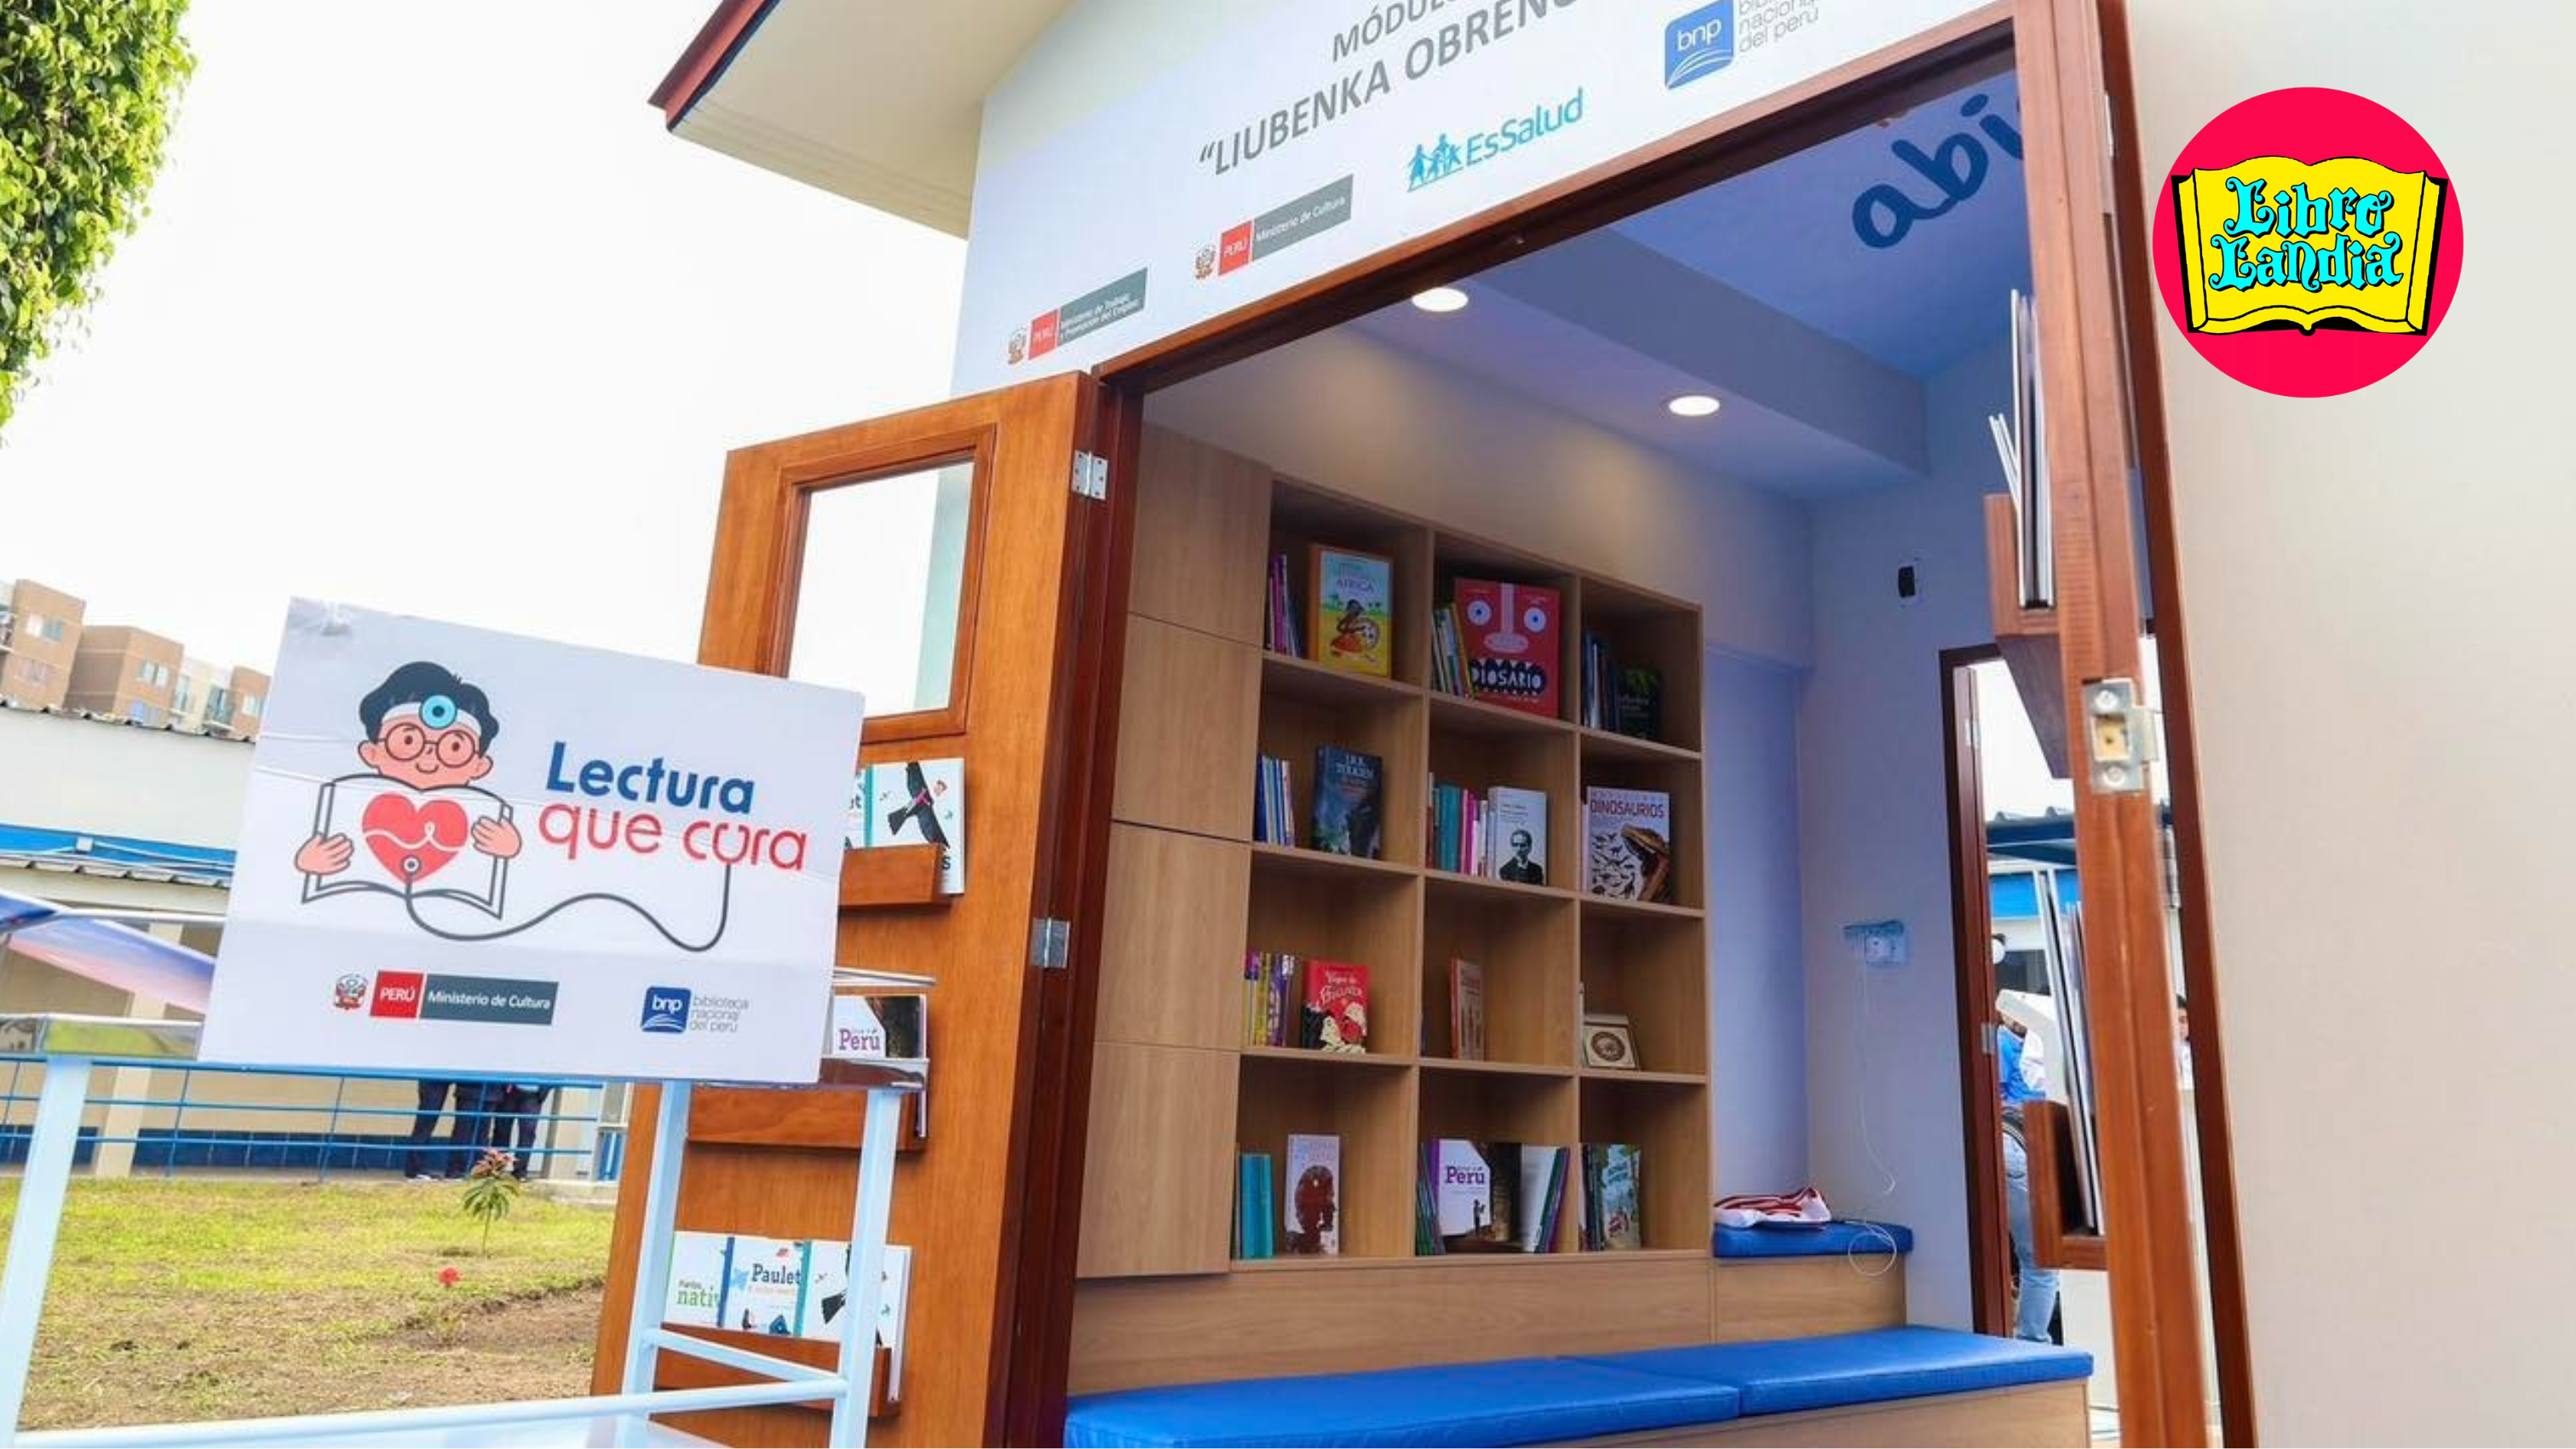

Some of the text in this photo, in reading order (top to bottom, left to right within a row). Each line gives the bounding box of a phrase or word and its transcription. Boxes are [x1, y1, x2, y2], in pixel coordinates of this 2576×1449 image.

[1332, 0, 1456, 62] MÓDUL
[1405, 0, 1577, 81] OBREN
[1677, 19, 1722, 52] bnp
[1739, 32, 1768, 52] del
[1467, 86, 1584, 166] EsSalud
[1852, 94, 2023, 249] abi
[1256, 196, 1346, 242] Ministerio de Cultura
[1471, 664, 1541, 689] DIOSARIO
[546, 740, 755, 814] Lectura
[1590, 799, 1665, 819] DINOSAURIOS
[538, 803, 808, 871] que cura
[380, 986, 416, 1003] PERÚ
[428, 991, 551, 1009] Ministerio de Cultura
[652, 993, 682, 1014] bnp
[839, 1028, 880, 1050] Perú
[1446, 1166, 1486, 1185] Perú
[752, 1263, 802, 1284] Paulet
